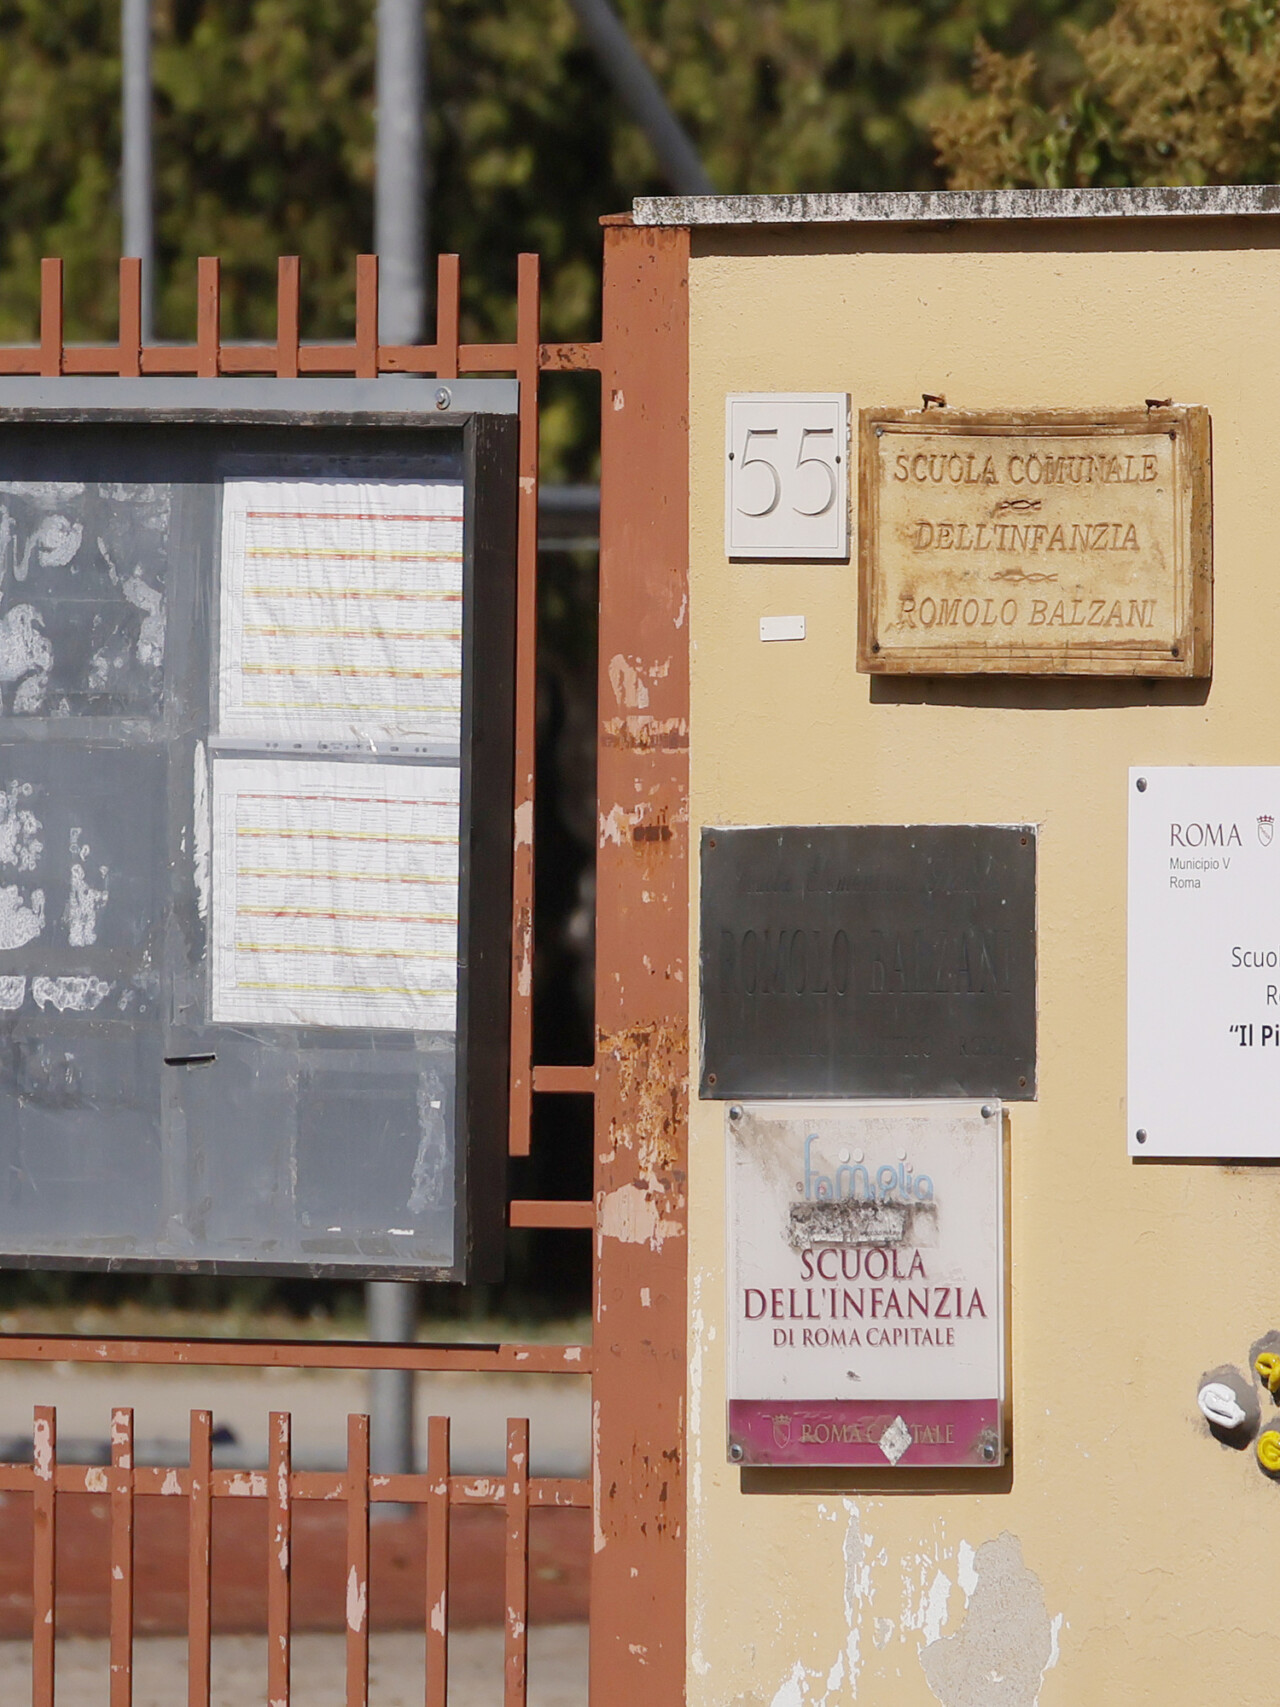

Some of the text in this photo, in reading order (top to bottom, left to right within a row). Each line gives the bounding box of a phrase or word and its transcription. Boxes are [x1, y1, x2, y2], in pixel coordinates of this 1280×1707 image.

[737, 428, 837, 518] 55
[894, 454, 1159, 486] SCUOLA COMUNALE
[912, 520, 1141, 552] DELL'INFANZIA
[896, 596, 1158, 630] ROMOLO BALZANI
[1170, 823, 1243, 848] ROMA
[1169, 857, 1231, 873] Municipio V
[1169, 876, 1201, 889] Roma
[800, 1248, 927, 1281] SCUOLA
[743, 1287, 988, 1320] DELL'INFANZIA
[773, 1327, 955, 1347] DI ROMA CAPITALE
[801, 1424, 863, 1444] ROMA
